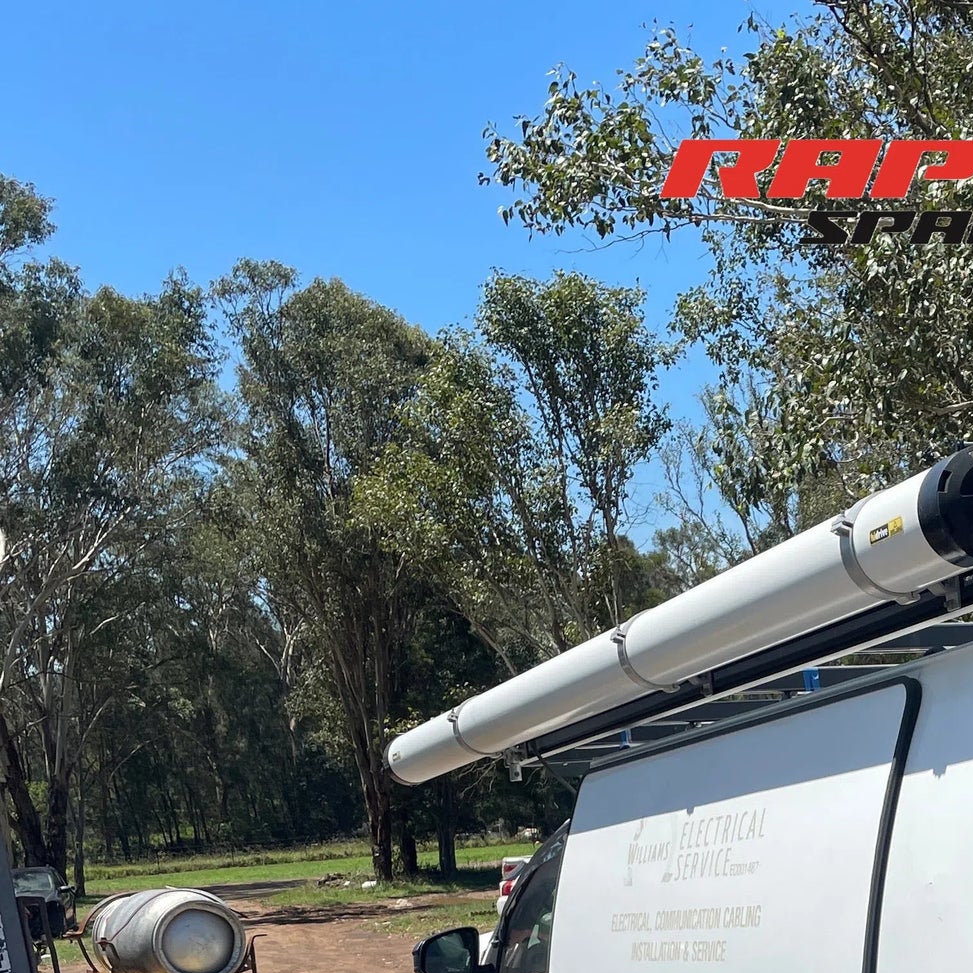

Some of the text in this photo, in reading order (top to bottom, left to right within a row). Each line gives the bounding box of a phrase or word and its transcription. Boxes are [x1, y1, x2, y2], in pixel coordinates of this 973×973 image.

[679, 808, 766, 850] ELECTRICAL
[627, 841, 670, 865] WILLIAMS
[674, 847, 732, 881] SERVICE
[655, 907, 722, 931] COMMUNICATION
[723, 904, 762, 928] CABLING
[631, 940, 727, 962] INSTALLATION & SERVICE
